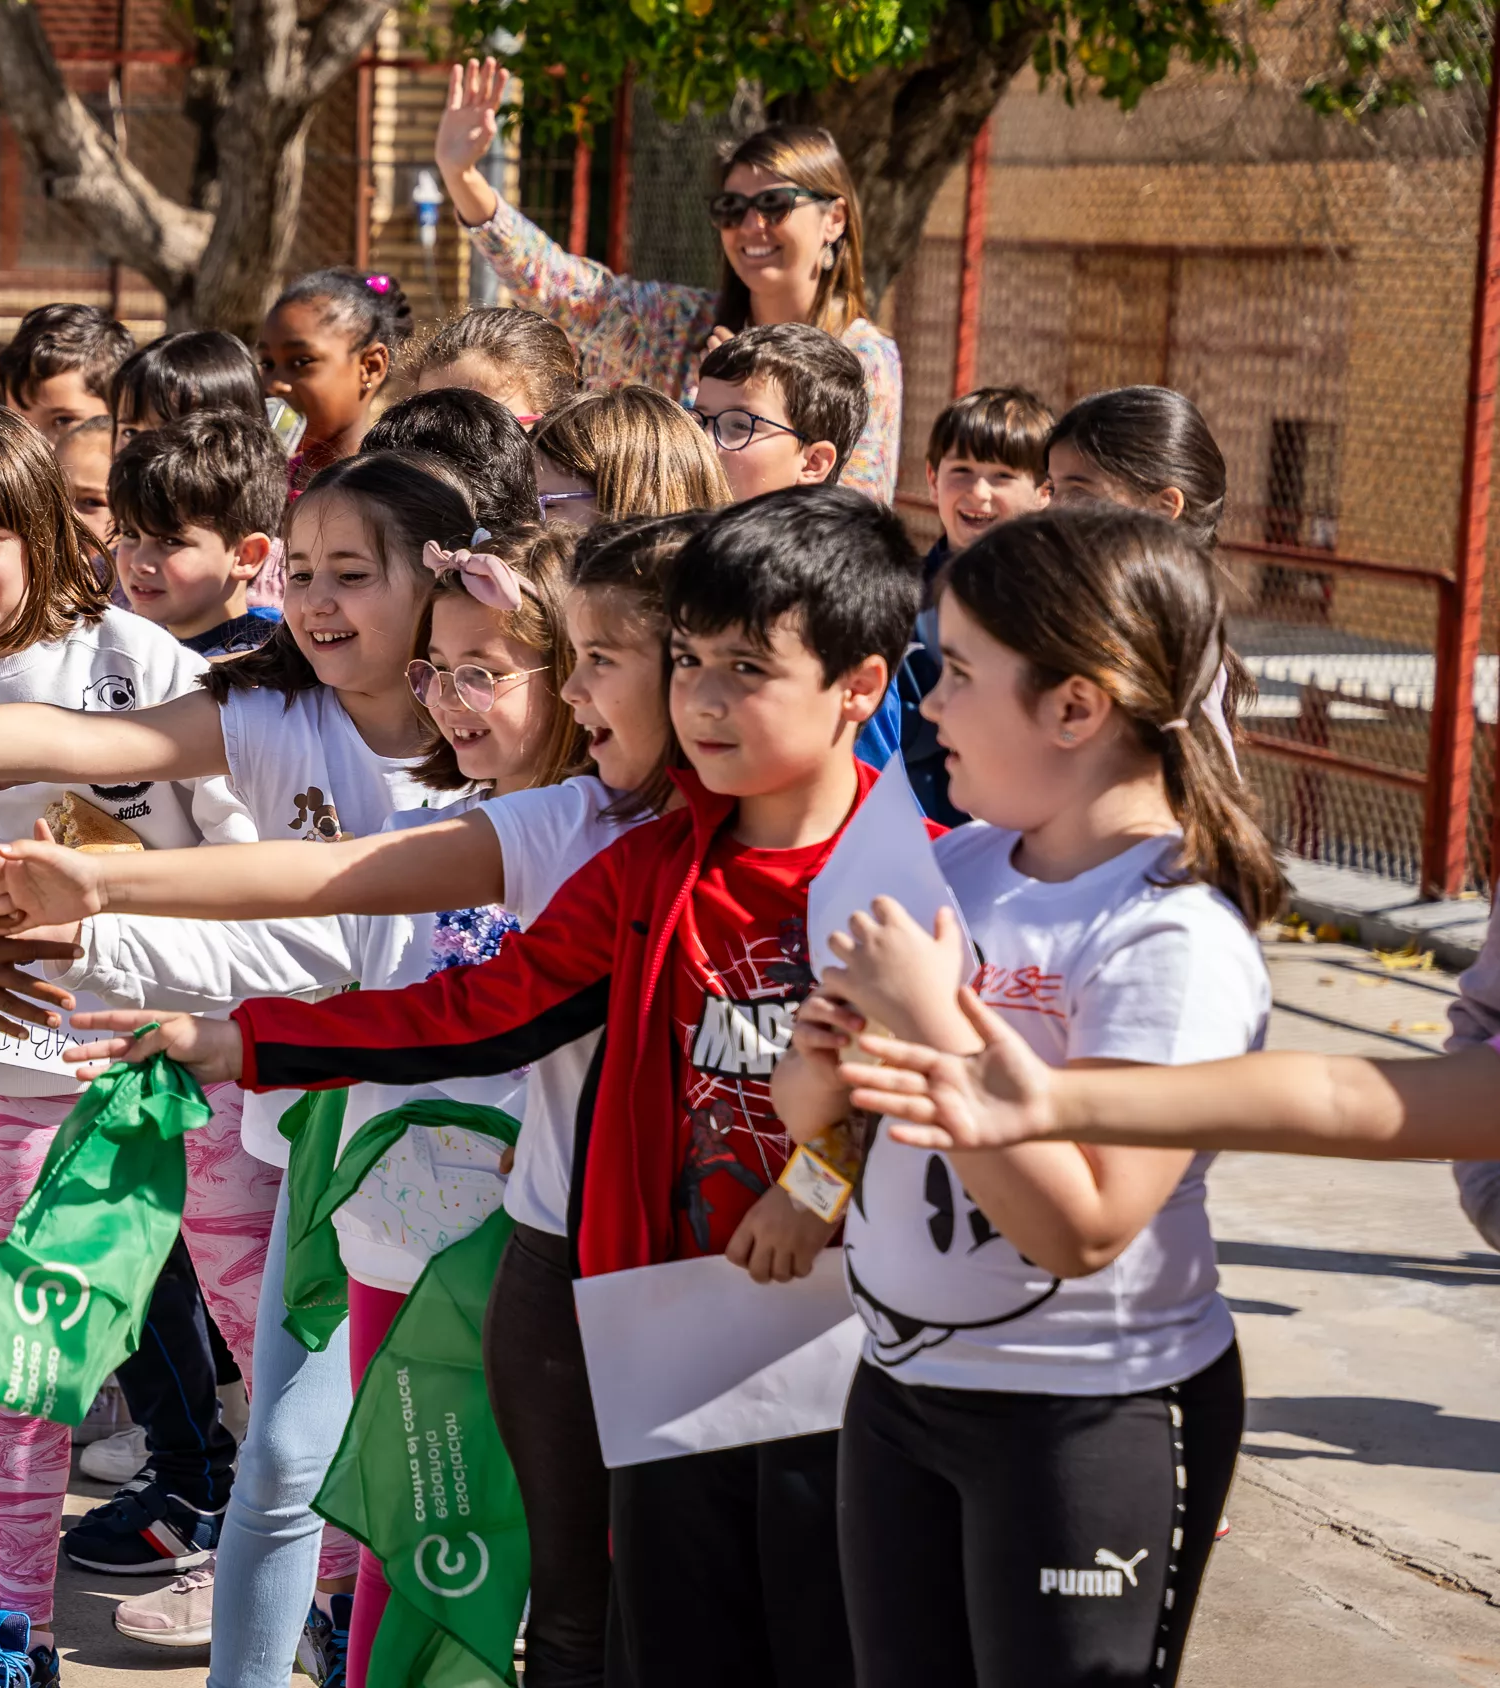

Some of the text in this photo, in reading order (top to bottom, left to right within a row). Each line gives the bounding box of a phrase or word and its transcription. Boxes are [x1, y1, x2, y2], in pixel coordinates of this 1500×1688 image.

[114, 800, 152, 821] Stitch
[3, 1334, 25, 1404] contra
[1040, 1568, 1123, 1597] PUMA
